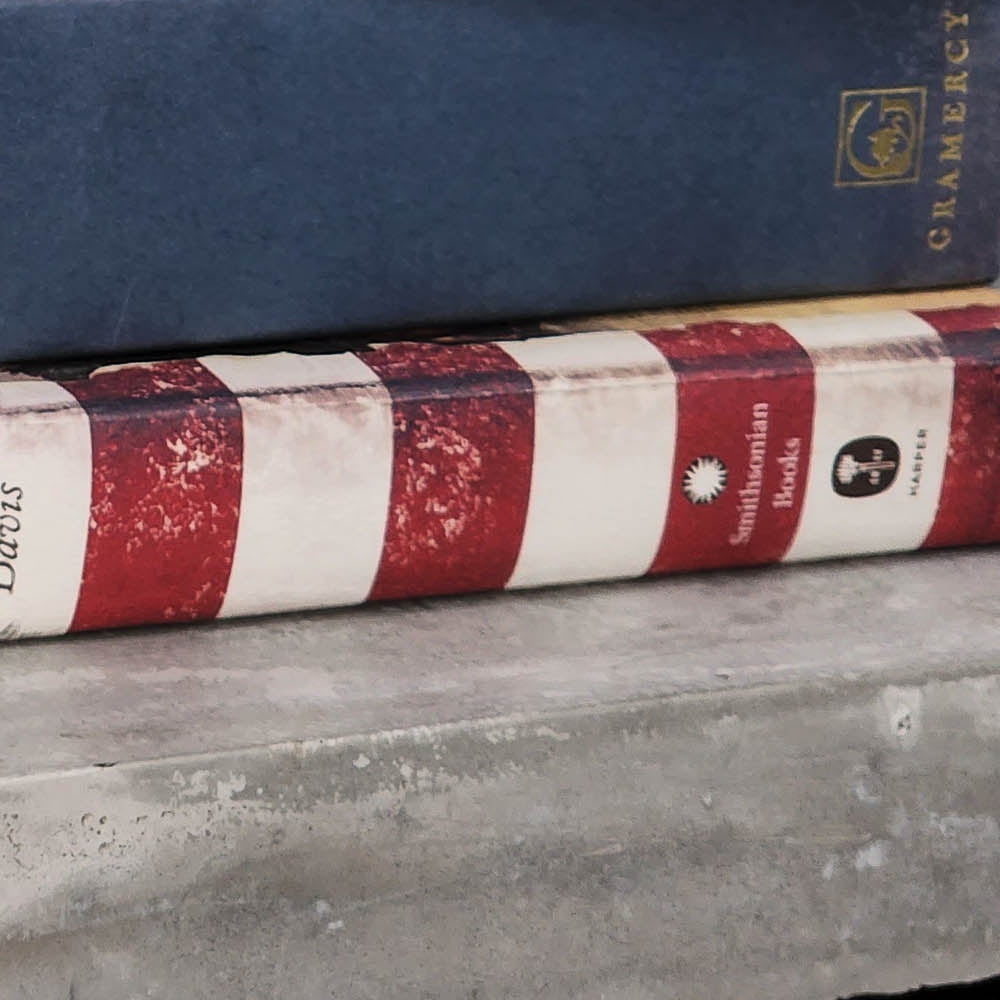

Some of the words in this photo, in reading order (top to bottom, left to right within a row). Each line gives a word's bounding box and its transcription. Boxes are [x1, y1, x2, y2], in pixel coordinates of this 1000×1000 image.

[926, 9, 970, 252] GRAMERCY
[729, 401, 769, 546] Smithsonian
[772, 436, 802, 509] Books
[909, 427, 928, 497] HARPER
